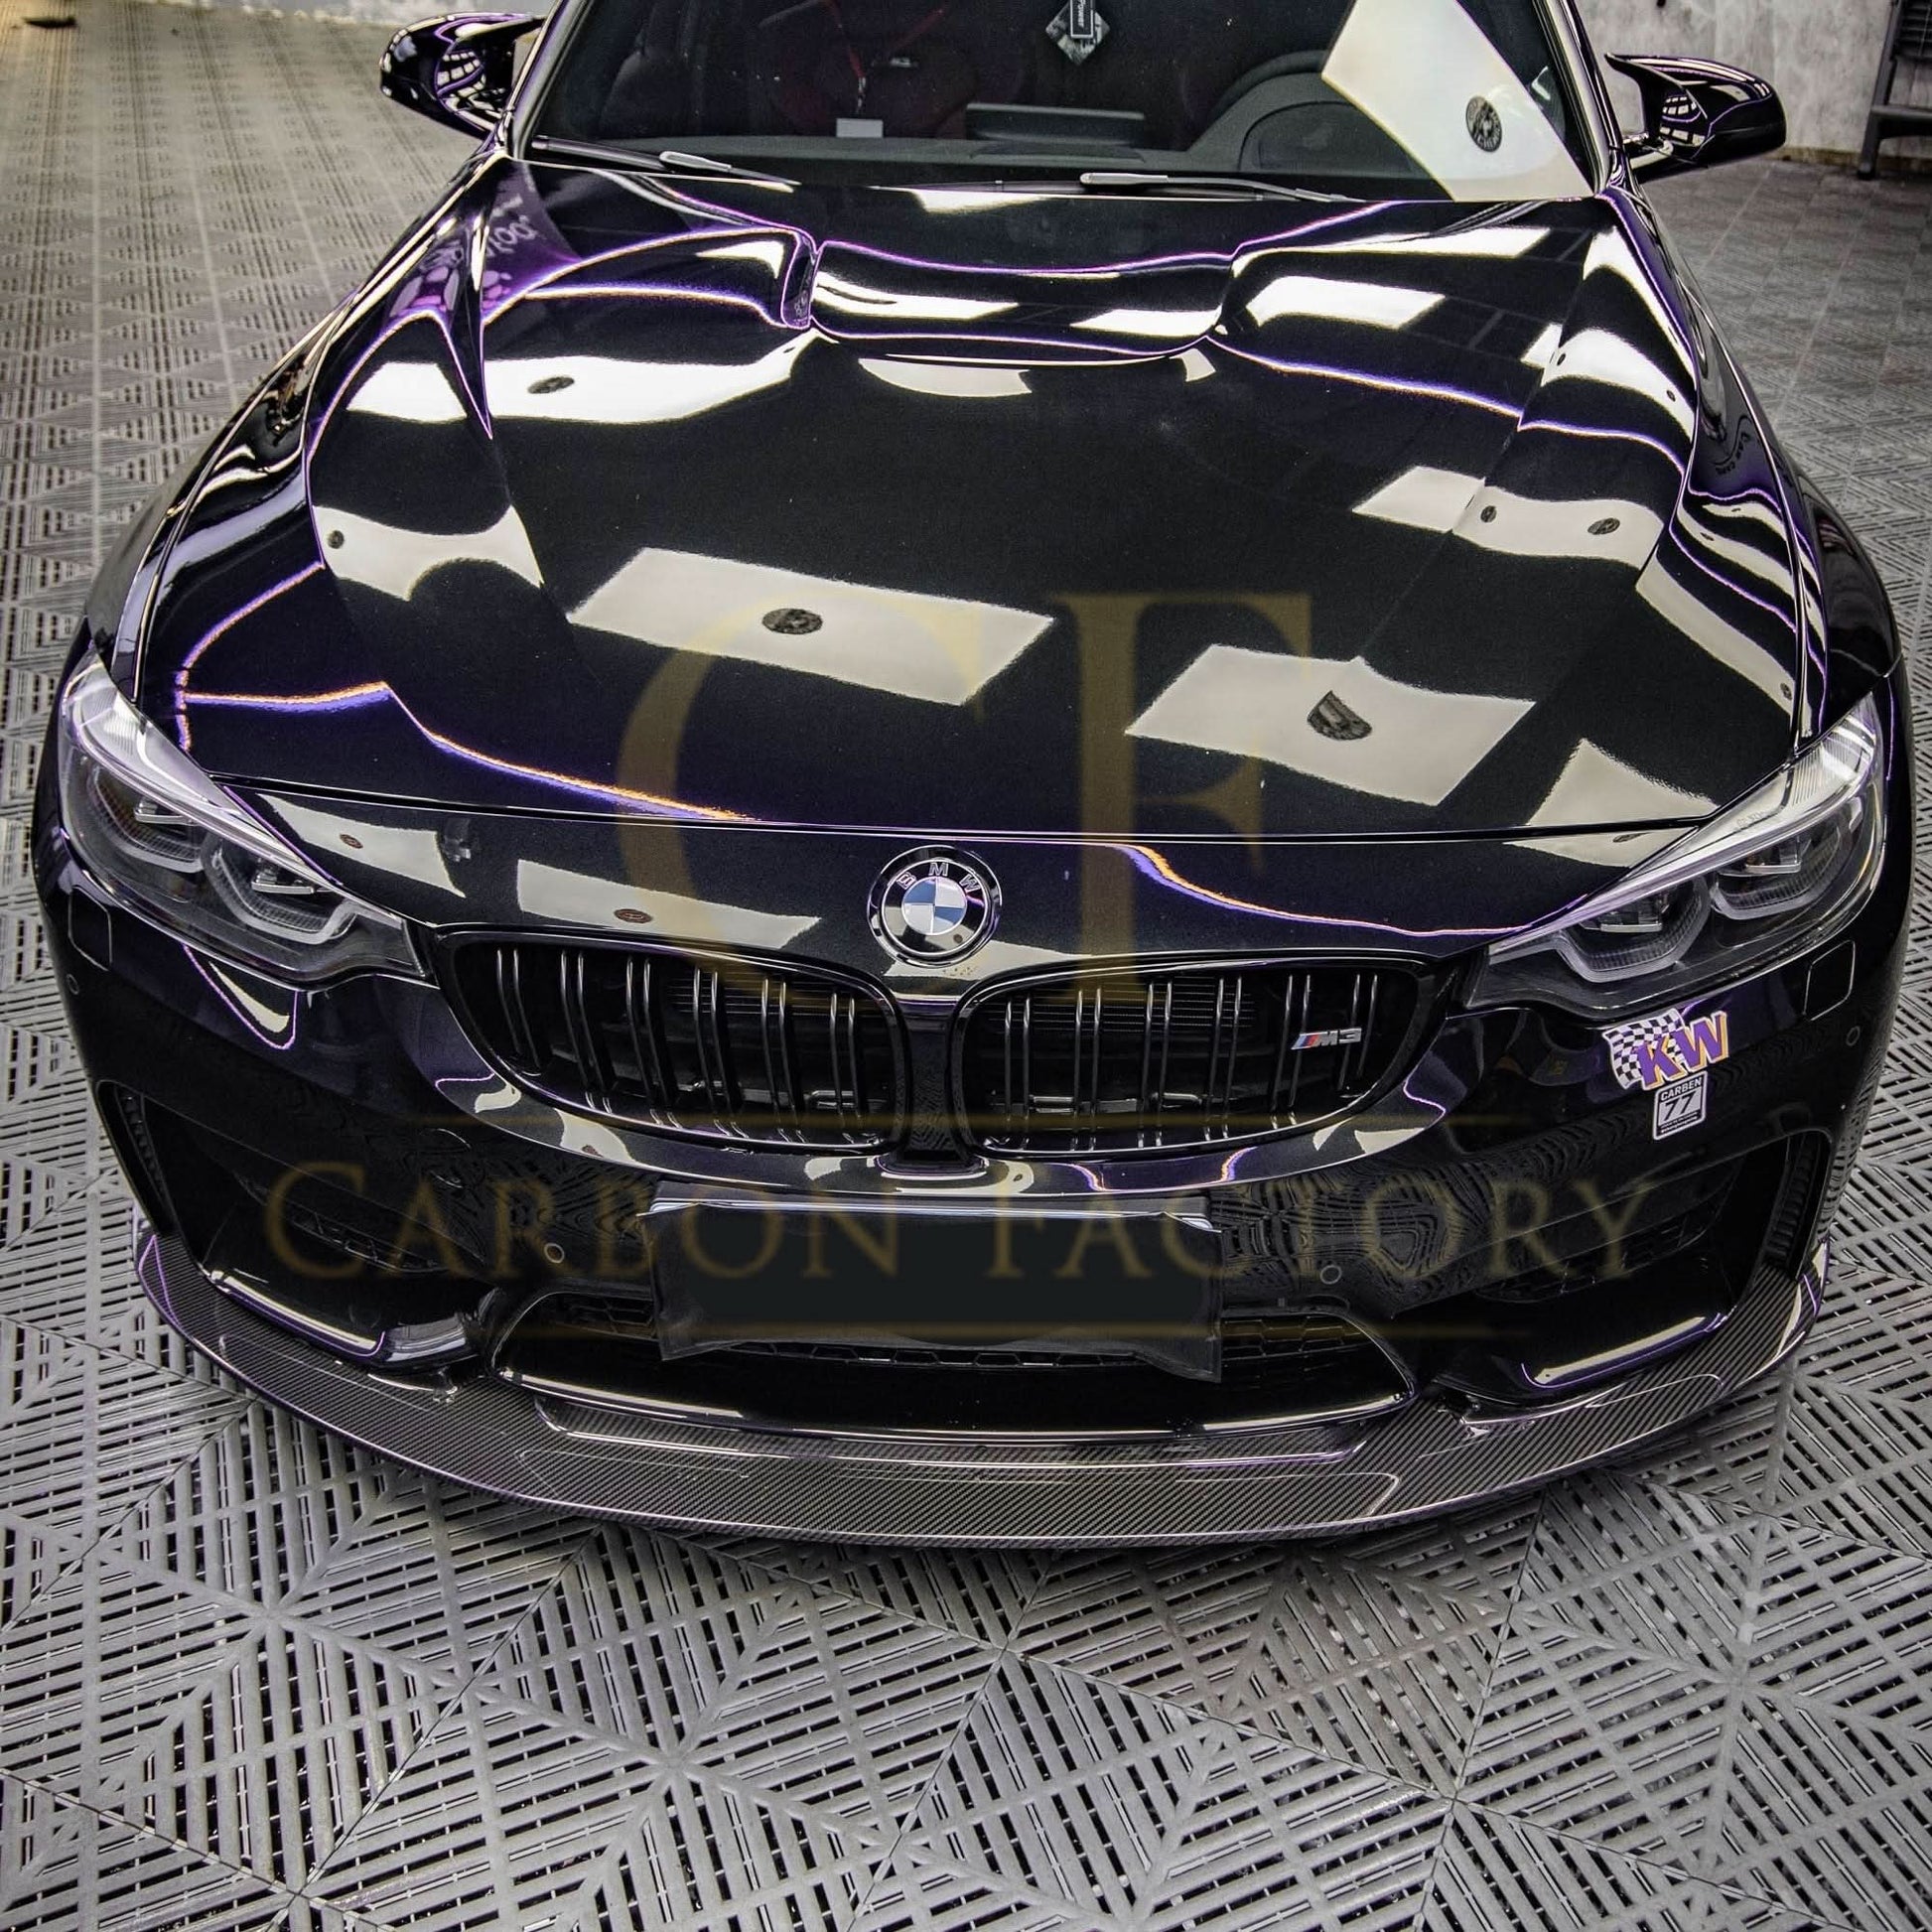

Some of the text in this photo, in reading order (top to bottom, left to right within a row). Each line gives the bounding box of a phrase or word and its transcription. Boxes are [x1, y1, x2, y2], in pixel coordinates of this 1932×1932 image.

[896, 862, 981, 894] BMW
[1307, 1028, 1362, 1047] M3
[1636, 1011, 1729, 1091] KW
[1660, 1076, 1703, 1101] CARBEN
[1664, 1091, 1696, 1122] 77
